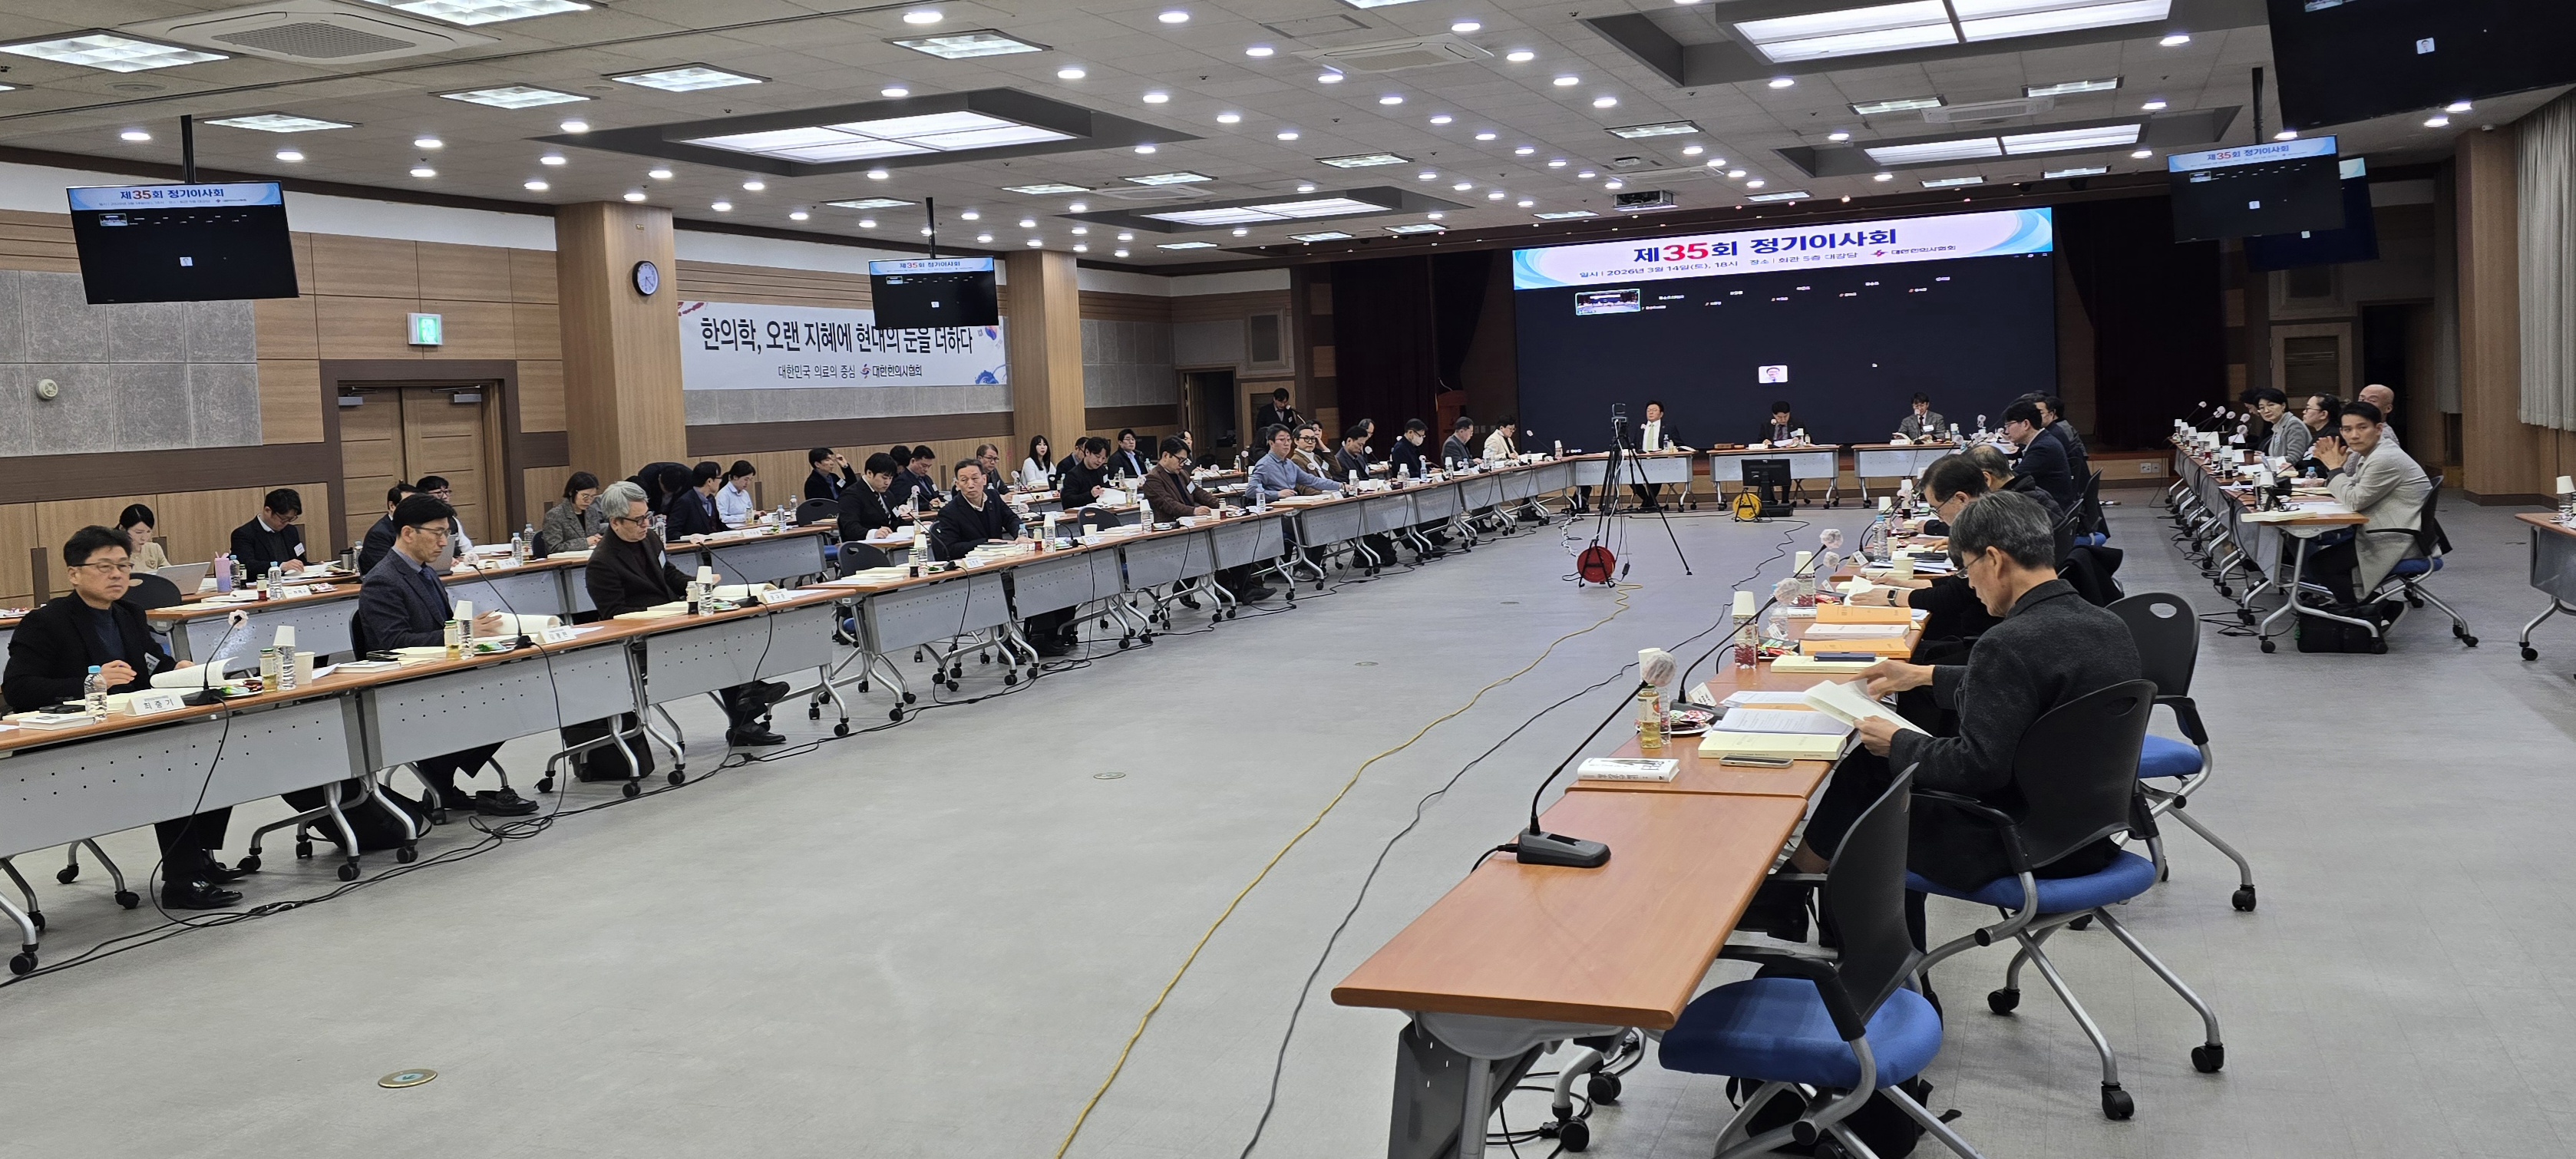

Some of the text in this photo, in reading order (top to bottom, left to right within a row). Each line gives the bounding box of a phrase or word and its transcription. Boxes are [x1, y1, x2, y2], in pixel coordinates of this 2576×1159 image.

[2207, 150, 2241, 161] 제35회
[2244, 144, 2290, 157] 정기이사회
[121, 188, 224, 200] 제35회 정기이사회
[1633, 229, 1897, 263] 제35회 정기이사회
[1579, 270, 1598, 279] 일시
[1607, 267, 1644, 276] 2026년
[1750, 257, 1769, 266] 장소
[1825, 252, 1858, 260] 대강당
[700, 317, 761, 355] 한의학,
[766, 320, 801, 352] 오랜
[804, 322, 853, 353] 지혜에
[856, 323, 900, 354] 현대의
[935, 326, 973, 355] 더하다
[778, 364, 855, 379] 대한민국 의료의 중심
[872, 365, 923, 378] 대한한의사협회
